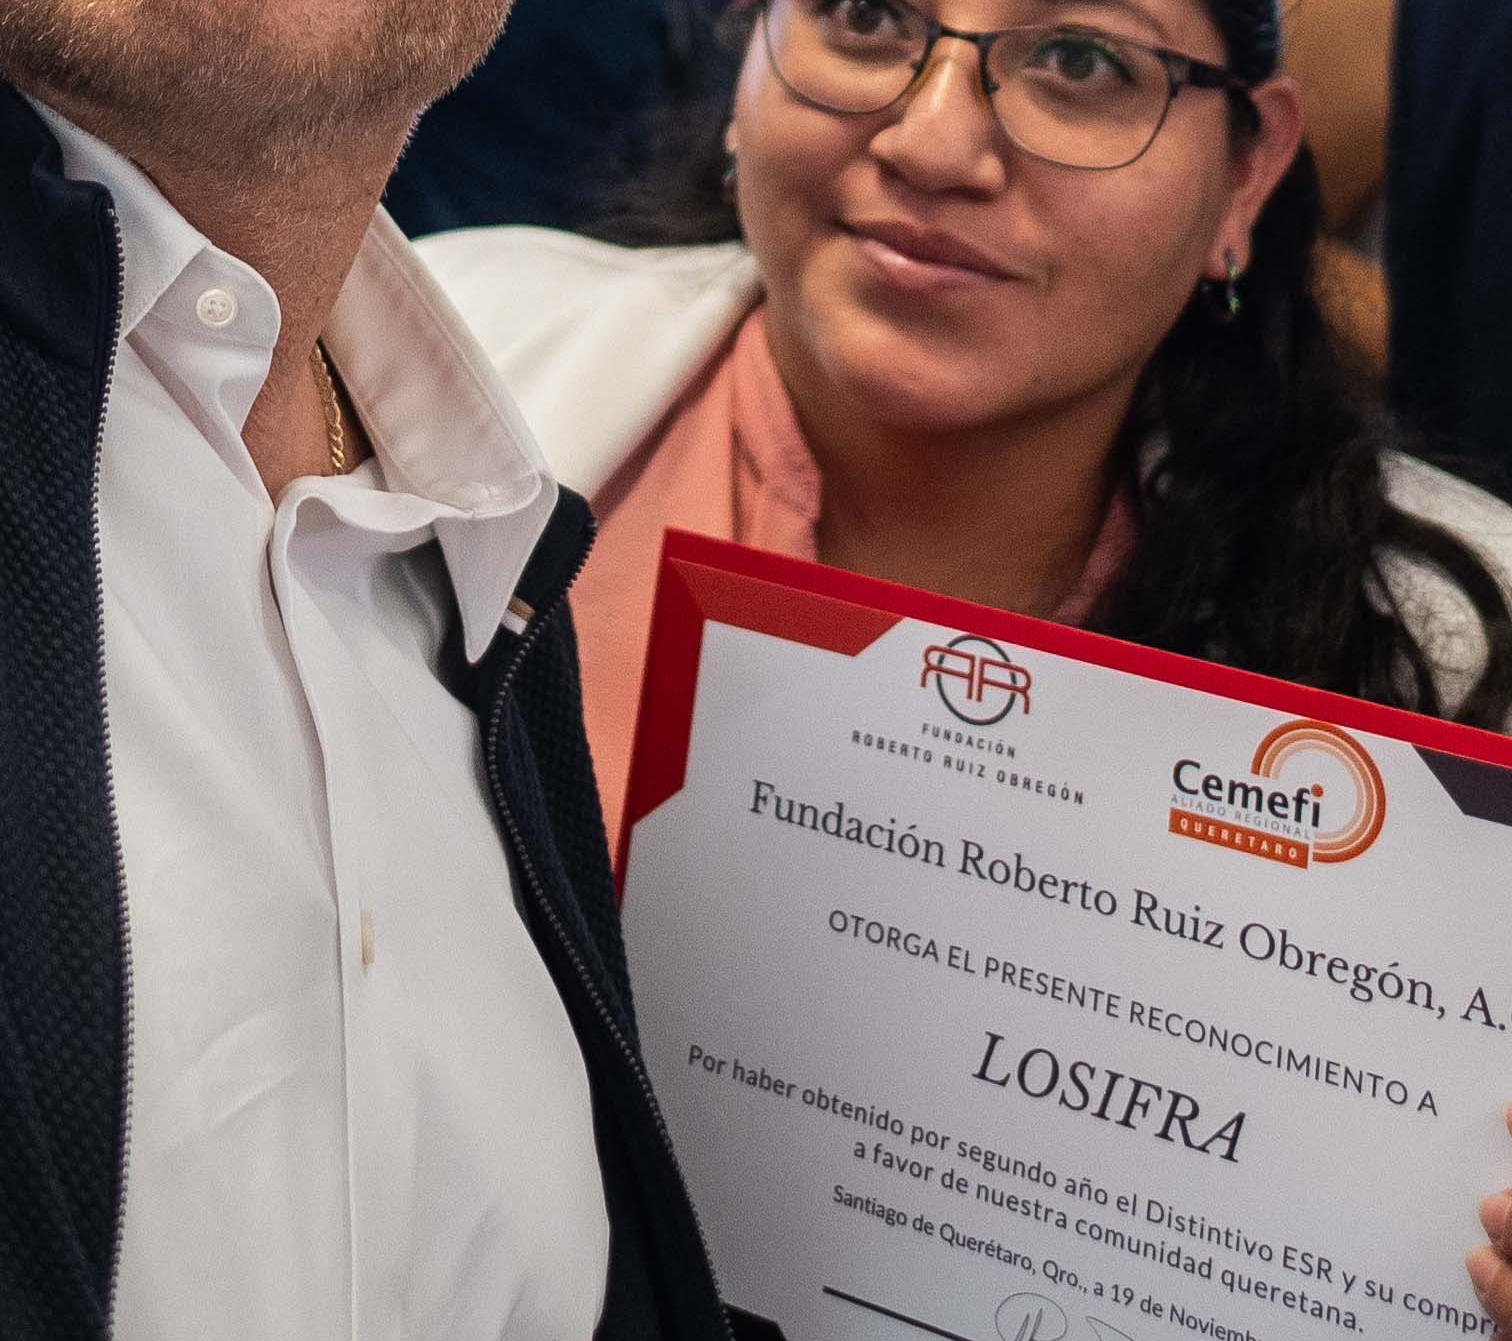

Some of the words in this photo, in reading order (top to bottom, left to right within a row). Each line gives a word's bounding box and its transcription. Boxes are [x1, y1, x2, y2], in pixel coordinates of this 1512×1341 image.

[850, 729, 933, 764] ROBERTO
[942, 754, 986, 779] RUIZ
[995, 768, 1084, 805] OBREGÓN
[920, 722, 1016, 759] FUNDACIÓN
[1172, 758, 1325, 829] Cemefi
[1170, 794, 1227, 818] ALIADO
[1233, 809, 1312, 840] REGIONAL
[748, 778, 945, 868] Fundación
[957, 838, 1118, 916] Roberto
[1130, 888, 1224, 950] Ruiz
[1238, 922, 1446, 1020] Obregón,
[827, 908, 939, 963] OTORGA
[946, 944, 976, 974] EL
[983, 955, 1121, 1019] PRESENTE
[1128, 999, 1409, 1106] RECONOCIMIENTO
[1416, 1089, 1438, 1117] A
[971, 1030, 1246, 1163] LOSIFRA
[687, 1043, 727, 1075] Por
[731, 1057, 797, 1099] haber
[800, 1086, 904, 1136] obtenido
[909, 1124, 951, 1151] por
[956, 1140, 1057, 1189] segundo
[1063, 1176, 1109, 1206] año
[1114, 1192, 1138, 1217] el
[1144, 1198, 1274, 1263] Distintivo
[1281, 1244, 1333, 1284] ESR
[1341, 1270, 1357, 1294] y
[1363, 1278, 1394, 1305] su
[1403, 1292, 1499, 1336] compr
[831, 1183, 908, 1227] Santiago
[910, 1213, 935, 1236] de
[938, 1221, 1036, 1275] Querétaro,
[1041, 1258, 1088, 1294] Qro.,
[1092, 1280, 1104, 1298] a
[1110, 1282, 1135, 1307] 19
[1138, 1294, 1164, 1319] de
[1169, 1304, 1262, 1341] Noviemb
[852, 1140, 866, 1160] a
[872, 1142, 935, 1182] favor
[940, 1167, 969, 1195] de
[974, 1182, 1068, 1230] nuestra
[1073, 1217, 1221, 1280] comunidad
[1220, 1268, 1365, 1334] queretana.
